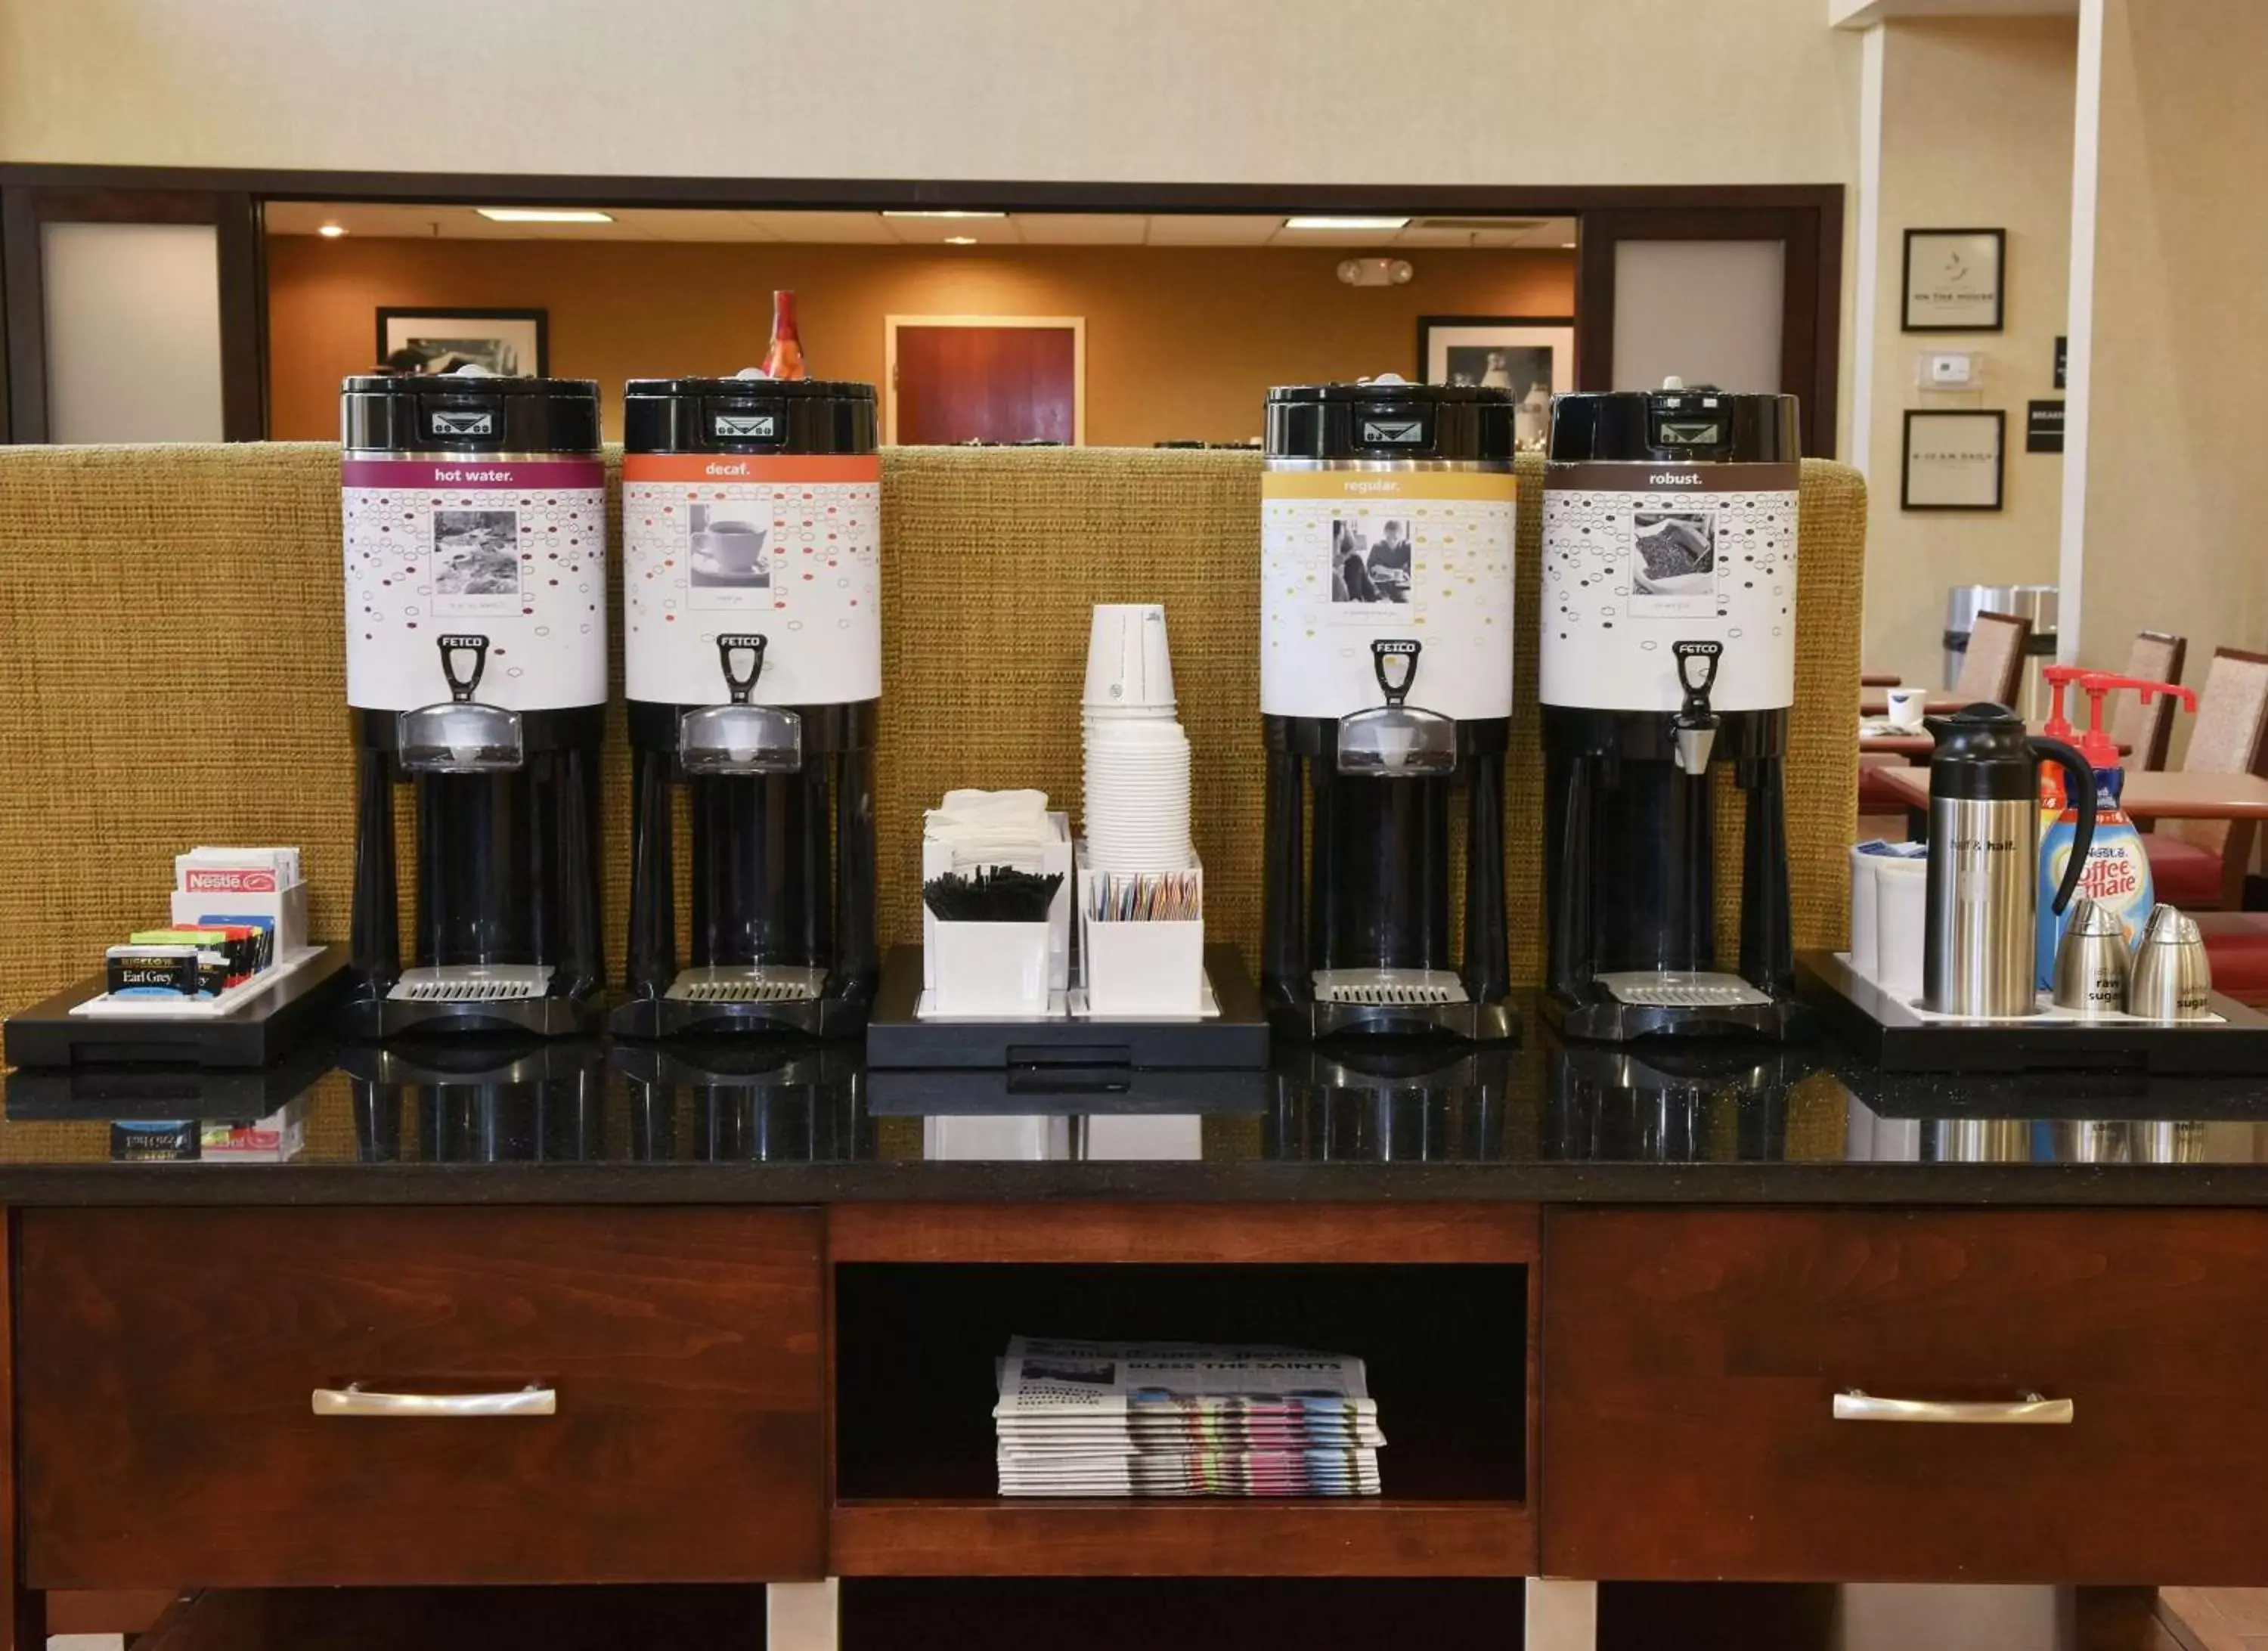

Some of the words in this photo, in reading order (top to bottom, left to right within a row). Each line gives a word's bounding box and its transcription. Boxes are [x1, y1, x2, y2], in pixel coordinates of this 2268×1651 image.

[435, 468, 463, 482] hot
[465, 469, 514, 482] water.
[705, 462, 751, 475] decaf.
[1649, 471, 1703, 485] robust.
[1343, 477, 1401, 494] regular.
[442, 637, 483, 646] FETCO
[720, 637, 761, 646] FETCO
[1376, 643, 1416, 652] FETCO
[1678, 644, 1718, 654] FETCO
[2079, 860, 2130, 883] offee
[122, 970, 145, 983] Earl
[146, 971, 174, 985] Grey
